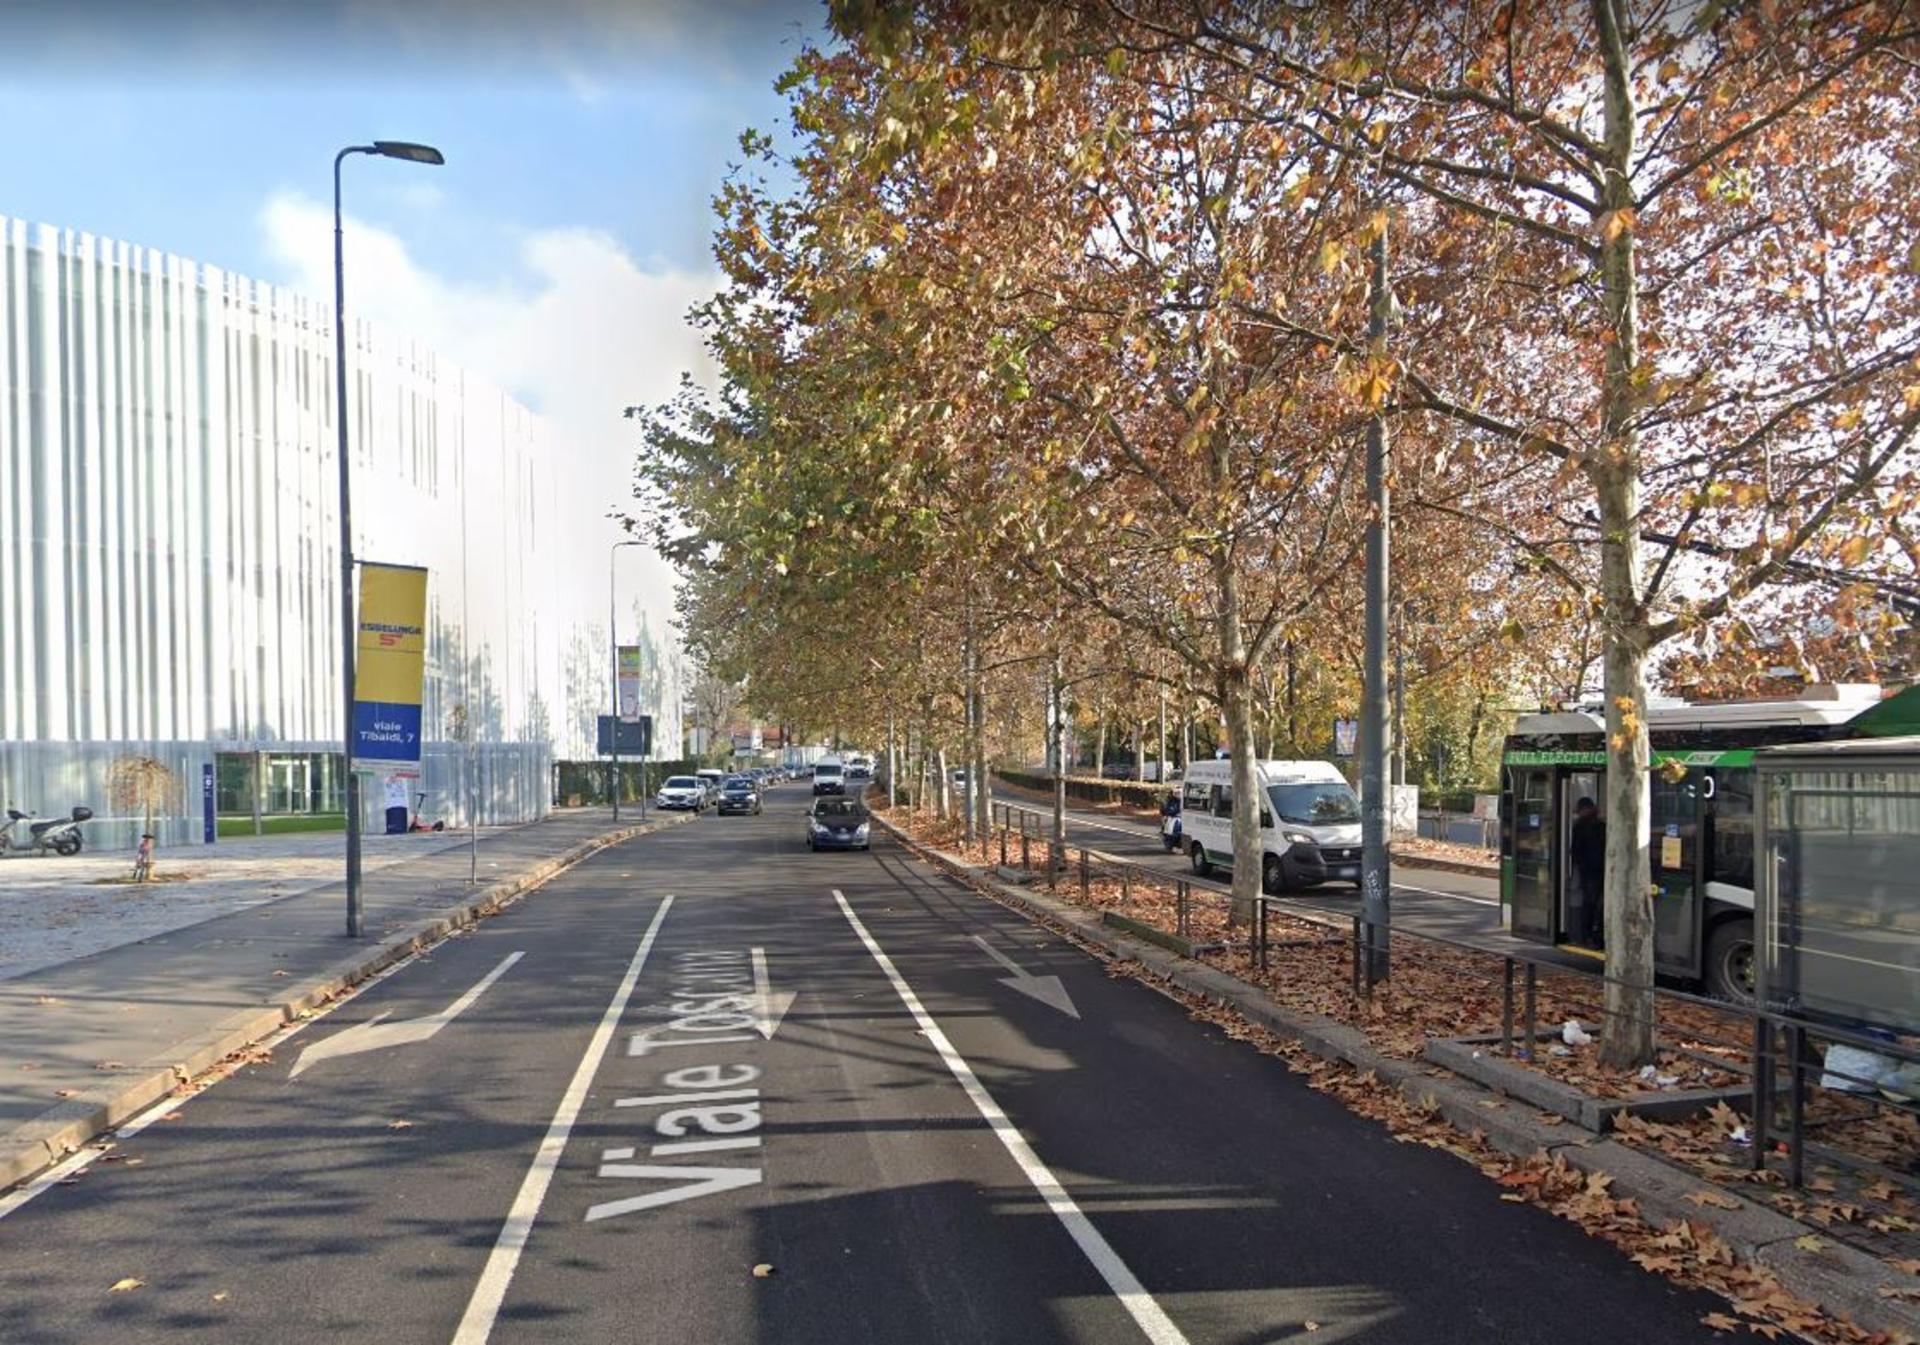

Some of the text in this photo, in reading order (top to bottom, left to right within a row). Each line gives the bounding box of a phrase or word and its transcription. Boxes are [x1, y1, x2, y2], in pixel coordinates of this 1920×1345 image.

[373, 721, 402, 731] viale
[360, 730, 415, 744] Tibaldi, 7
[1541, 751, 1606, 764] ELECTRIC
[585, 1063, 762, 1223] Viale
